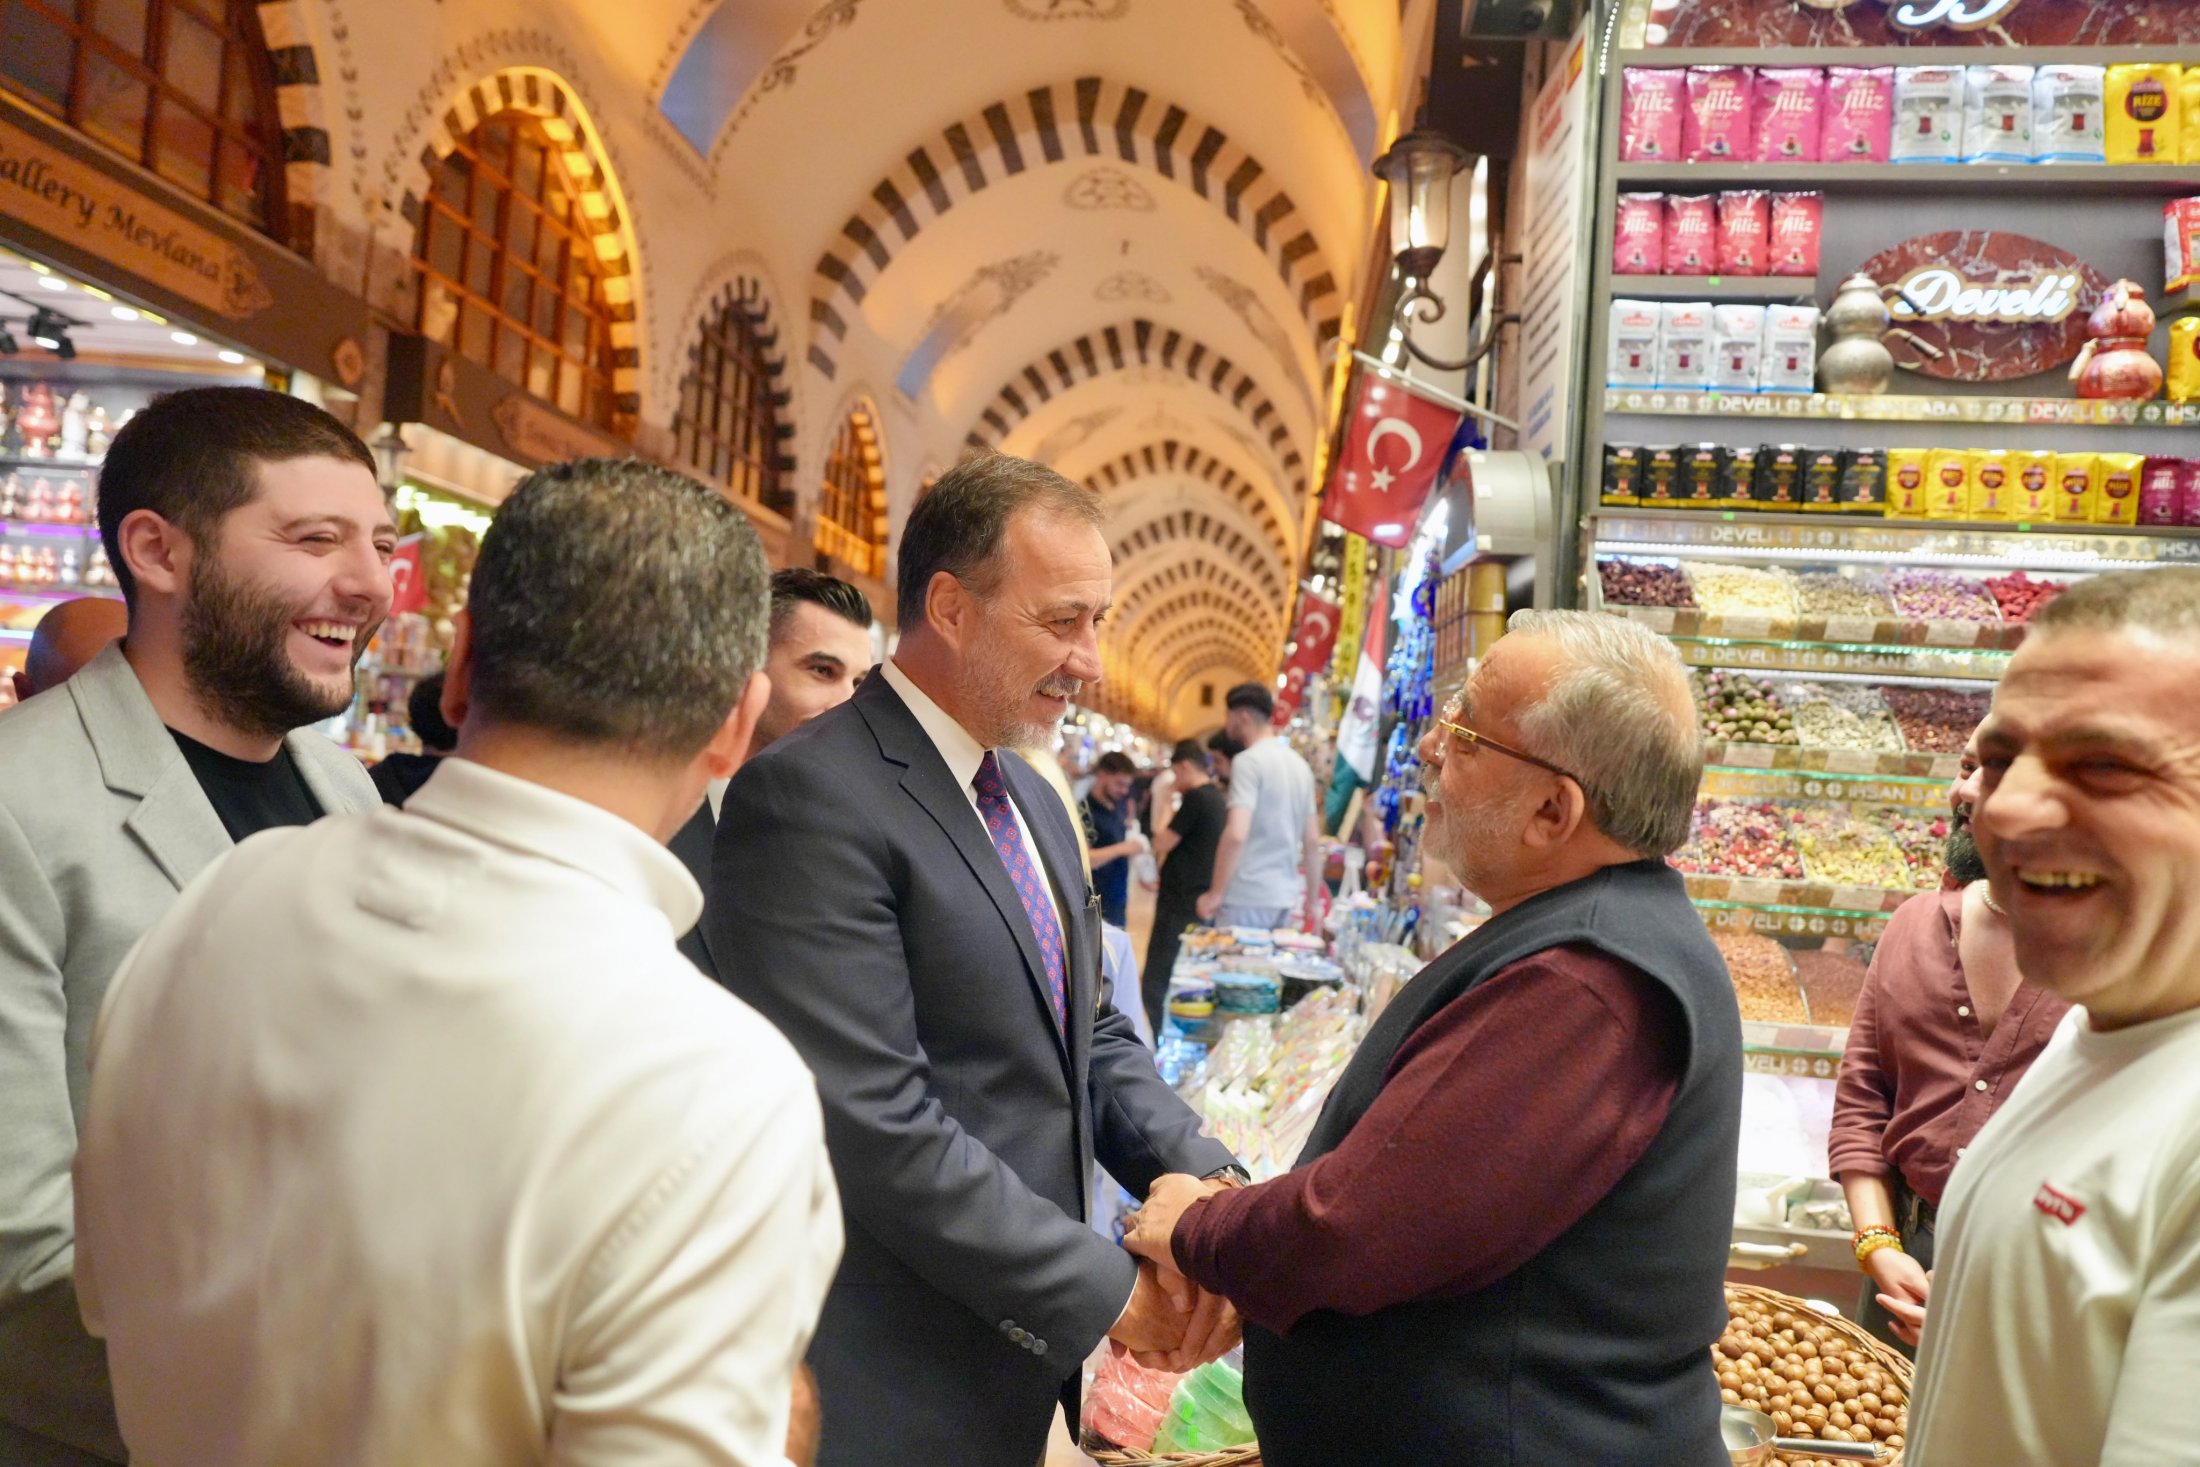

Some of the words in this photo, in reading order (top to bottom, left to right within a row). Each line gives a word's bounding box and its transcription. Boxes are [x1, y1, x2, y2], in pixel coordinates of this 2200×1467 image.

[0, 156, 96, 229] allery
[103, 204, 220, 283] Mevlana
[1893, 269, 2076, 317] Develi
[1908, 400, 1960, 417] ABA
[1743, 1053, 1786, 1071] VELI
